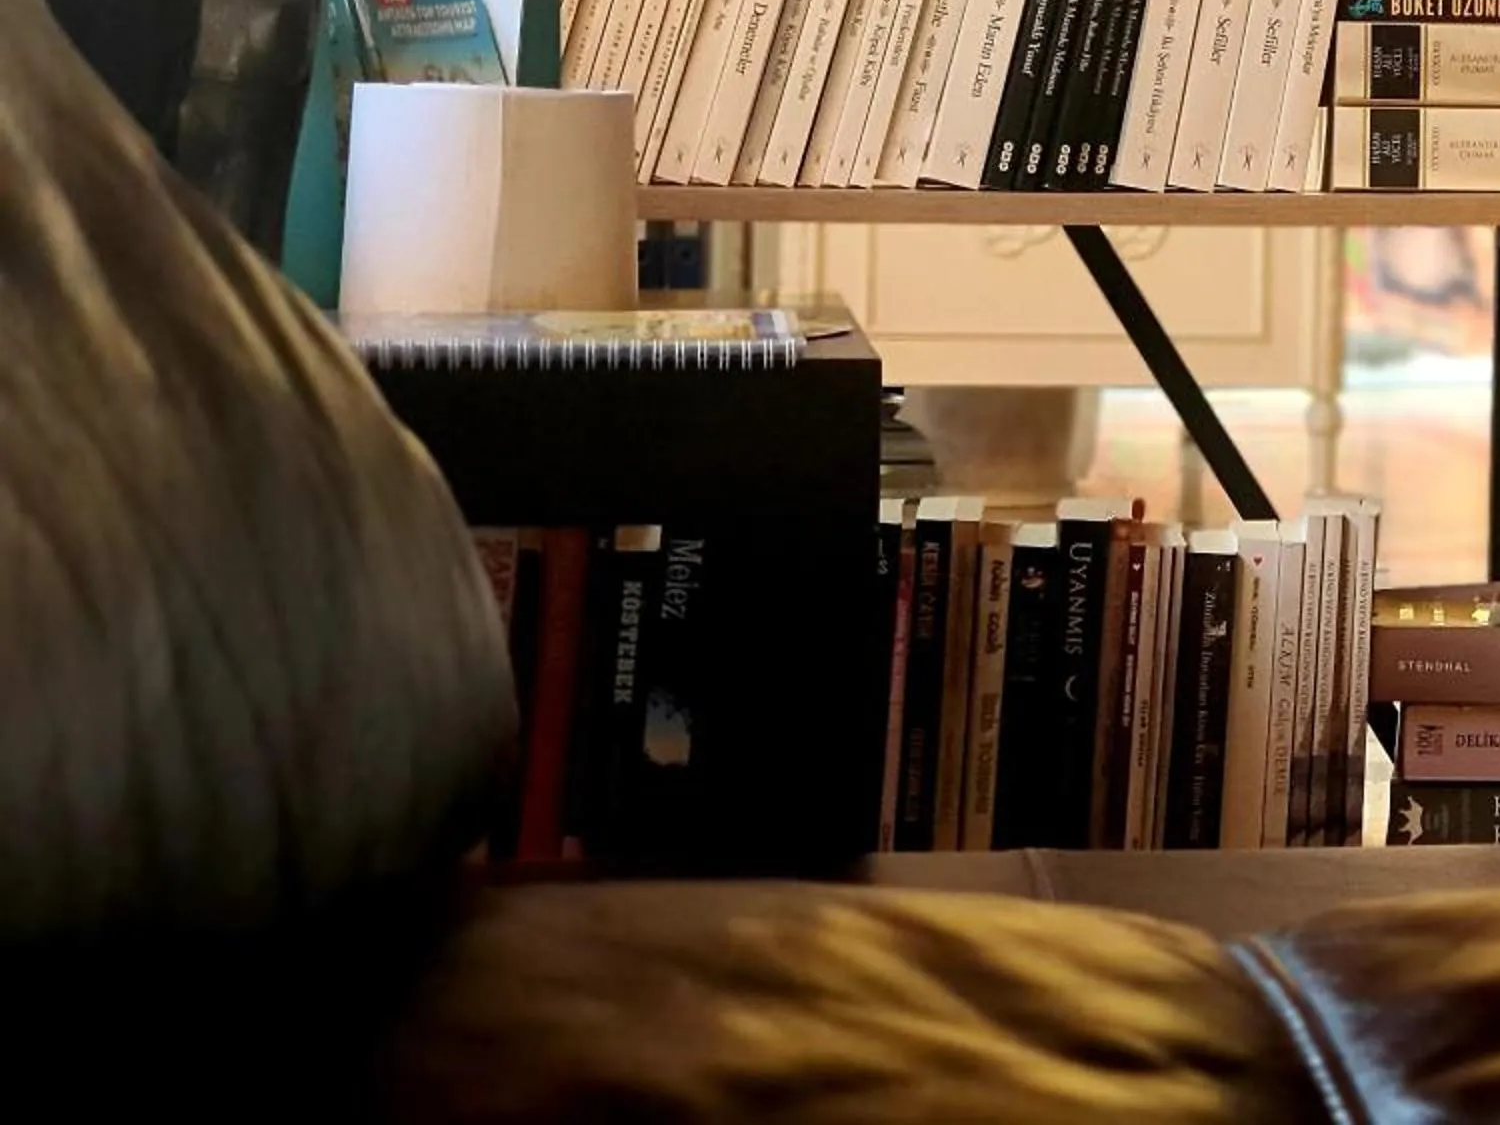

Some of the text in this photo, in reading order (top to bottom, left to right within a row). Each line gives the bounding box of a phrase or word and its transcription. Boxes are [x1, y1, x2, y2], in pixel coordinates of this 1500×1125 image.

[735, 2, 768, 74] Denemeler
[981, 14, 1003, 60] Martin
[1210, 17, 1230, 64] Sefiller
[1261, 18, 1280, 64] Sefiller
[661, 539, 703, 617] Melez
[1398, 660, 1471, 672] STENDHAL
